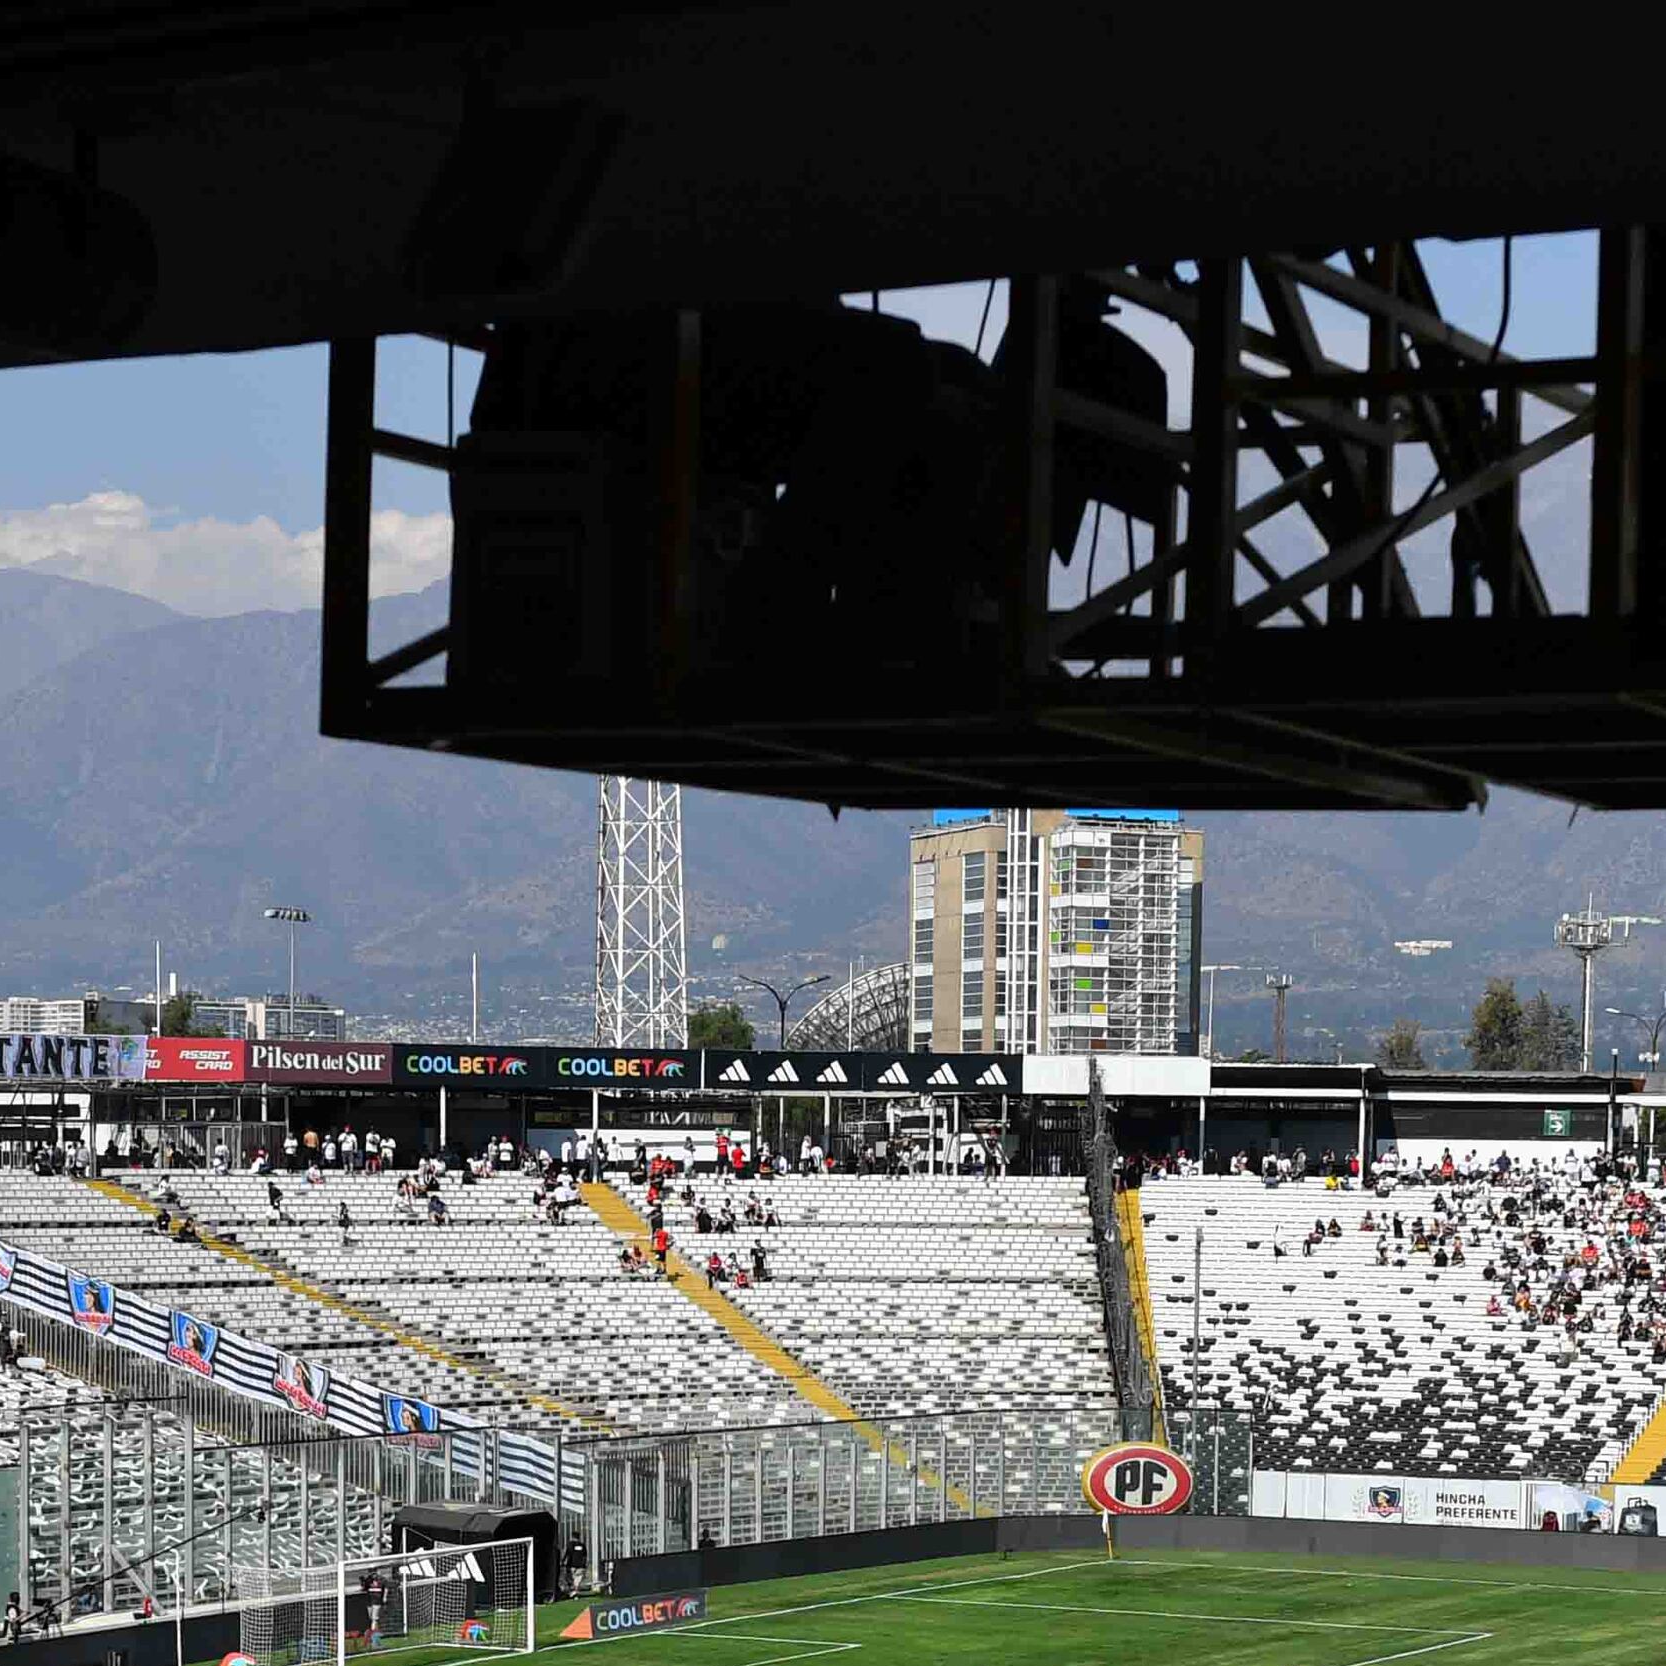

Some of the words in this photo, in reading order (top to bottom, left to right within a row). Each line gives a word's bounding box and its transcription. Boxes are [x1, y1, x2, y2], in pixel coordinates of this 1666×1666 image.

[179, 1050, 230, 1061] ASSIST
[195, 1061, 233, 1070] CARD
[252, 1045, 319, 1069] Pilsen
[322, 1055, 343, 1070] del
[346, 1051, 385, 1075] Sur
[407, 1055, 497, 1075] COOLBET
[558, 1057, 654, 1077] COOLBET
[1115, 1460, 1167, 1505] PF
[1436, 1493, 1485, 1505] HINCHA
[1436, 1506, 1517, 1520] PREFERENTE
[596, 1599, 675, 1631] COOLBET
